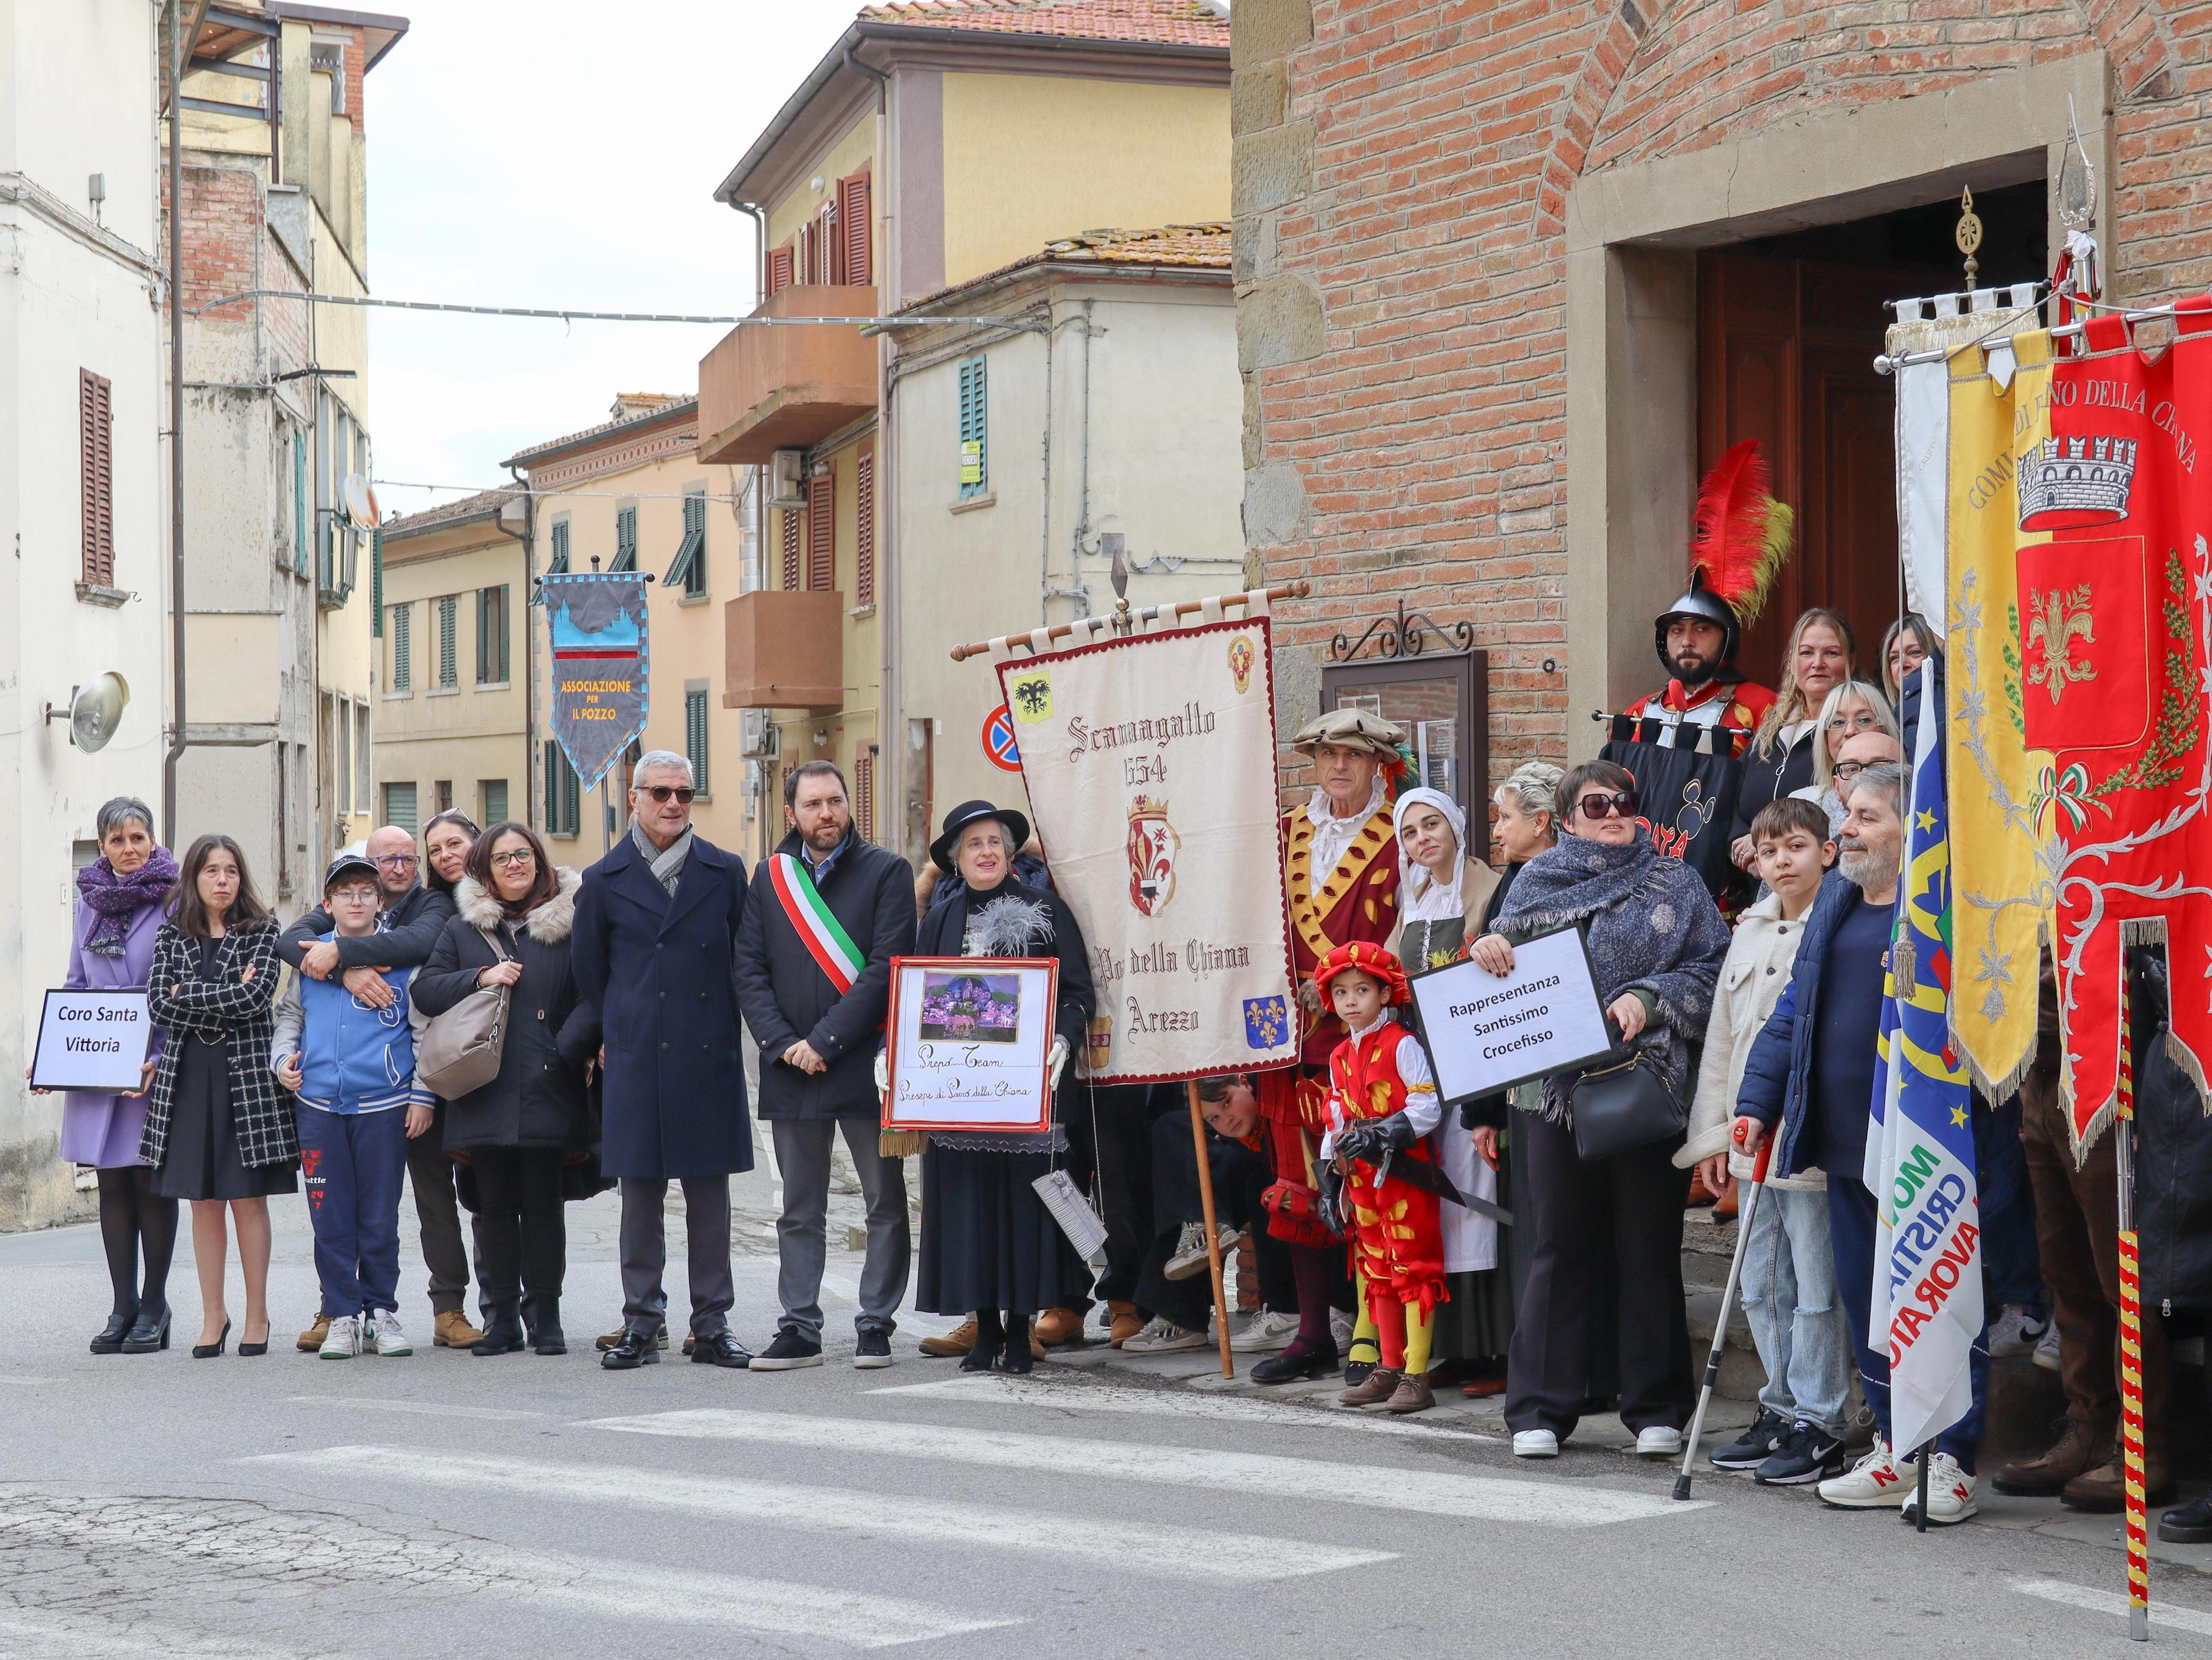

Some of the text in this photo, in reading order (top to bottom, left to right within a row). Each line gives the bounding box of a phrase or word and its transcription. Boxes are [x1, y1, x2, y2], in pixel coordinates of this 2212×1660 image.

[2084, 379, 2146, 415] DELLA
[561, 680, 630, 692] ASSOCIAZIONE
[586, 695, 598, 703] PER
[572, 708, 616, 720] IL POZZO
[1130, 941, 1177, 975] della
[1449, 974, 1561, 1018] Rappresentanza
[58, 1006, 138, 1022] Coro Santa
[1126, 996, 1199, 1044] Arezzo
[1473, 1004, 1549, 1037] Santissimo
[65, 1036, 121, 1052] Vittoria
[962, 1044, 1004, 1068] Team
[1483, 1029, 1553, 1059] Crocefisso
[899, 1079, 933, 1106] Presepe
[935, 1087, 946, 1099] di
[972, 1086, 993, 1097] della
[995, 1080, 1031, 1097] Chiana
